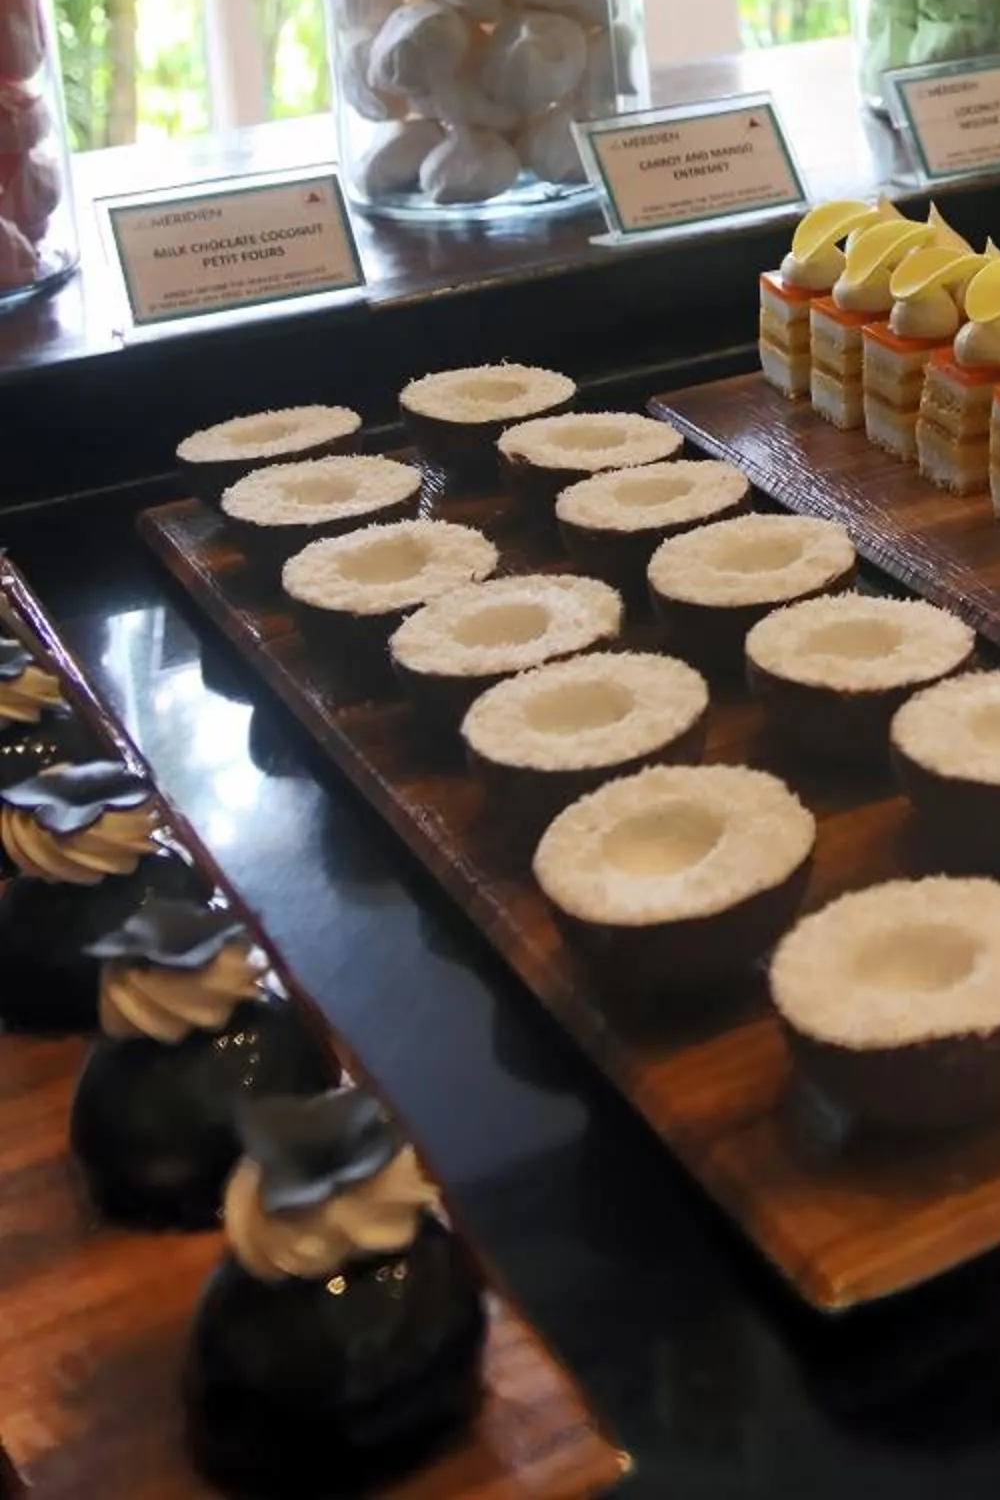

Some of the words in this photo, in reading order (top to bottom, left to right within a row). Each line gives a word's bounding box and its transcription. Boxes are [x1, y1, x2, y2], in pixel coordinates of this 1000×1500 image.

[684, 150, 710, 164] AND
[151, 208, 223, 229] MERIDIEN
[153, 245, 188, 260] MILK
[190, 234, 257, 254] CHOCLATE
[260, 222, 324, 245] COCONUT
[202, 253, 239, 269] PETIT
[241, 245, 286, 264] FOURS
